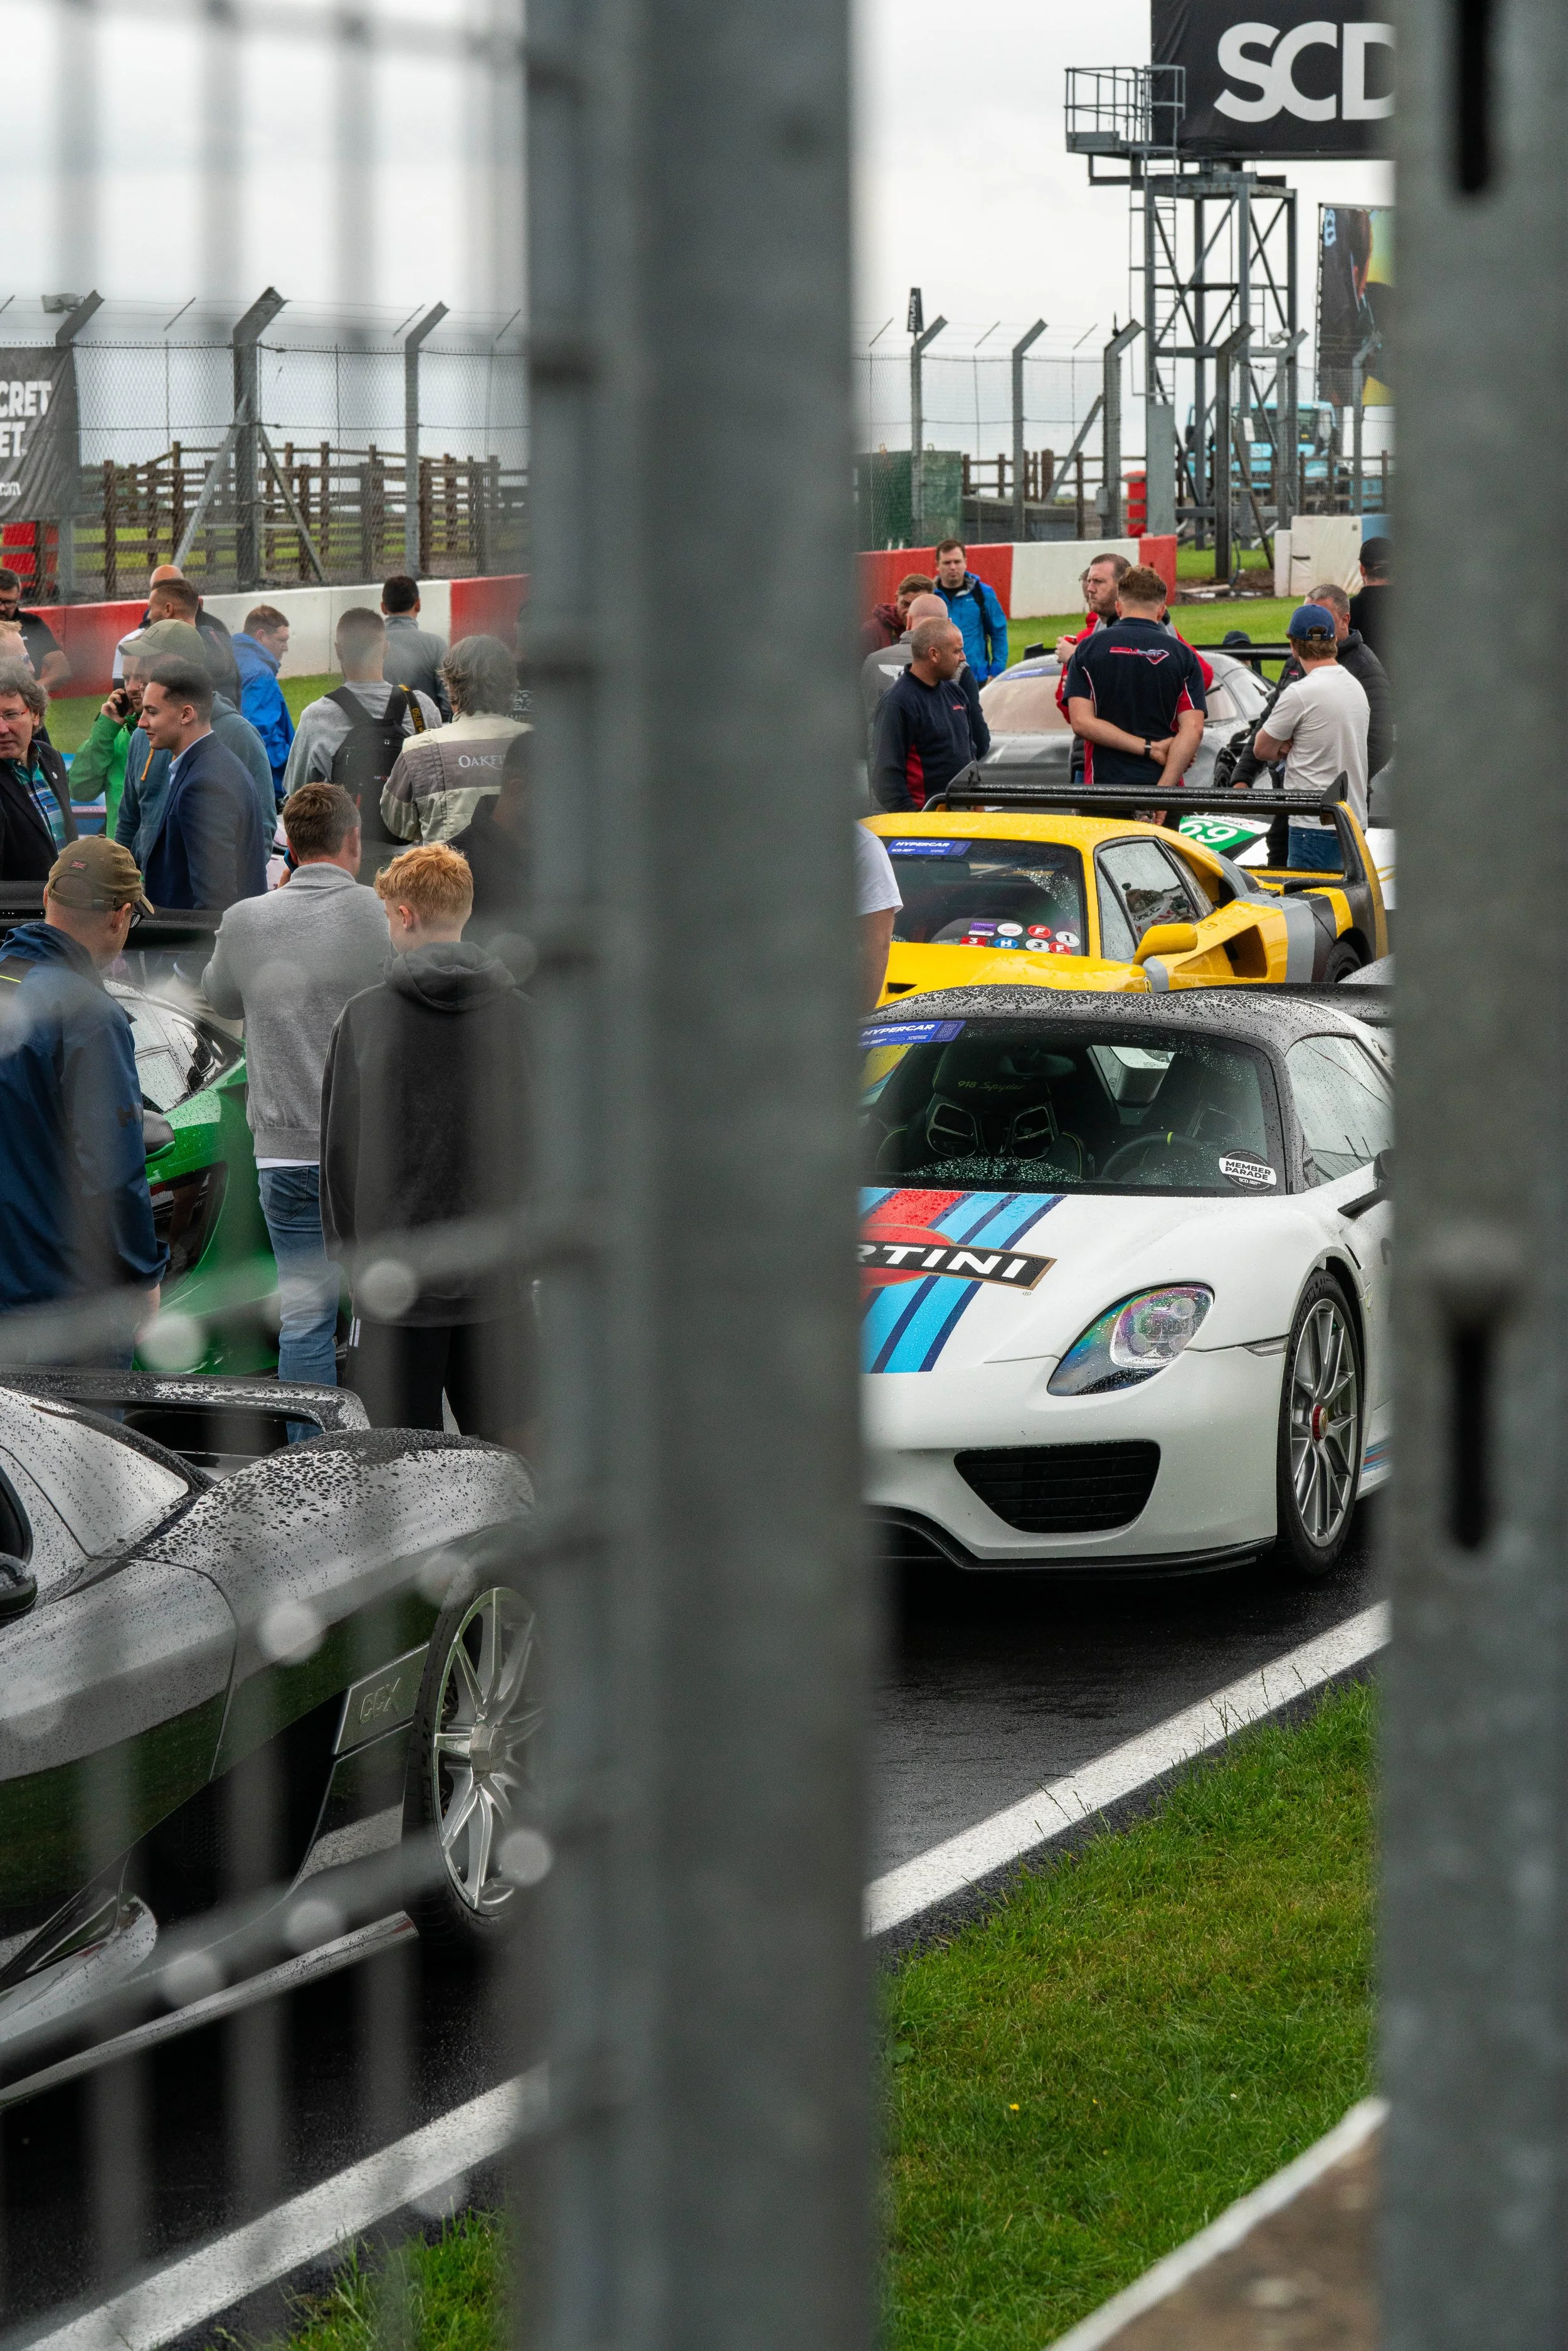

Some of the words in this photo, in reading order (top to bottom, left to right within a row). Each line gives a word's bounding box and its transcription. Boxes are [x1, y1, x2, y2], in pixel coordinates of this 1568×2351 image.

[1214, 21, 1396, 122] SCD
[1179, 820, 1239, 844] 69
[1000, 940, 1012, 948] H
[861, 1024, 935, 1036] HYPERCAR
[978, 1081, 1026, 1093] Spyder
[1225, 1166, 1268, 1181] PARADE
[1226, 1160, 1271, 1176] MEMBER
[359, 1677, 401, 1724] CCX
